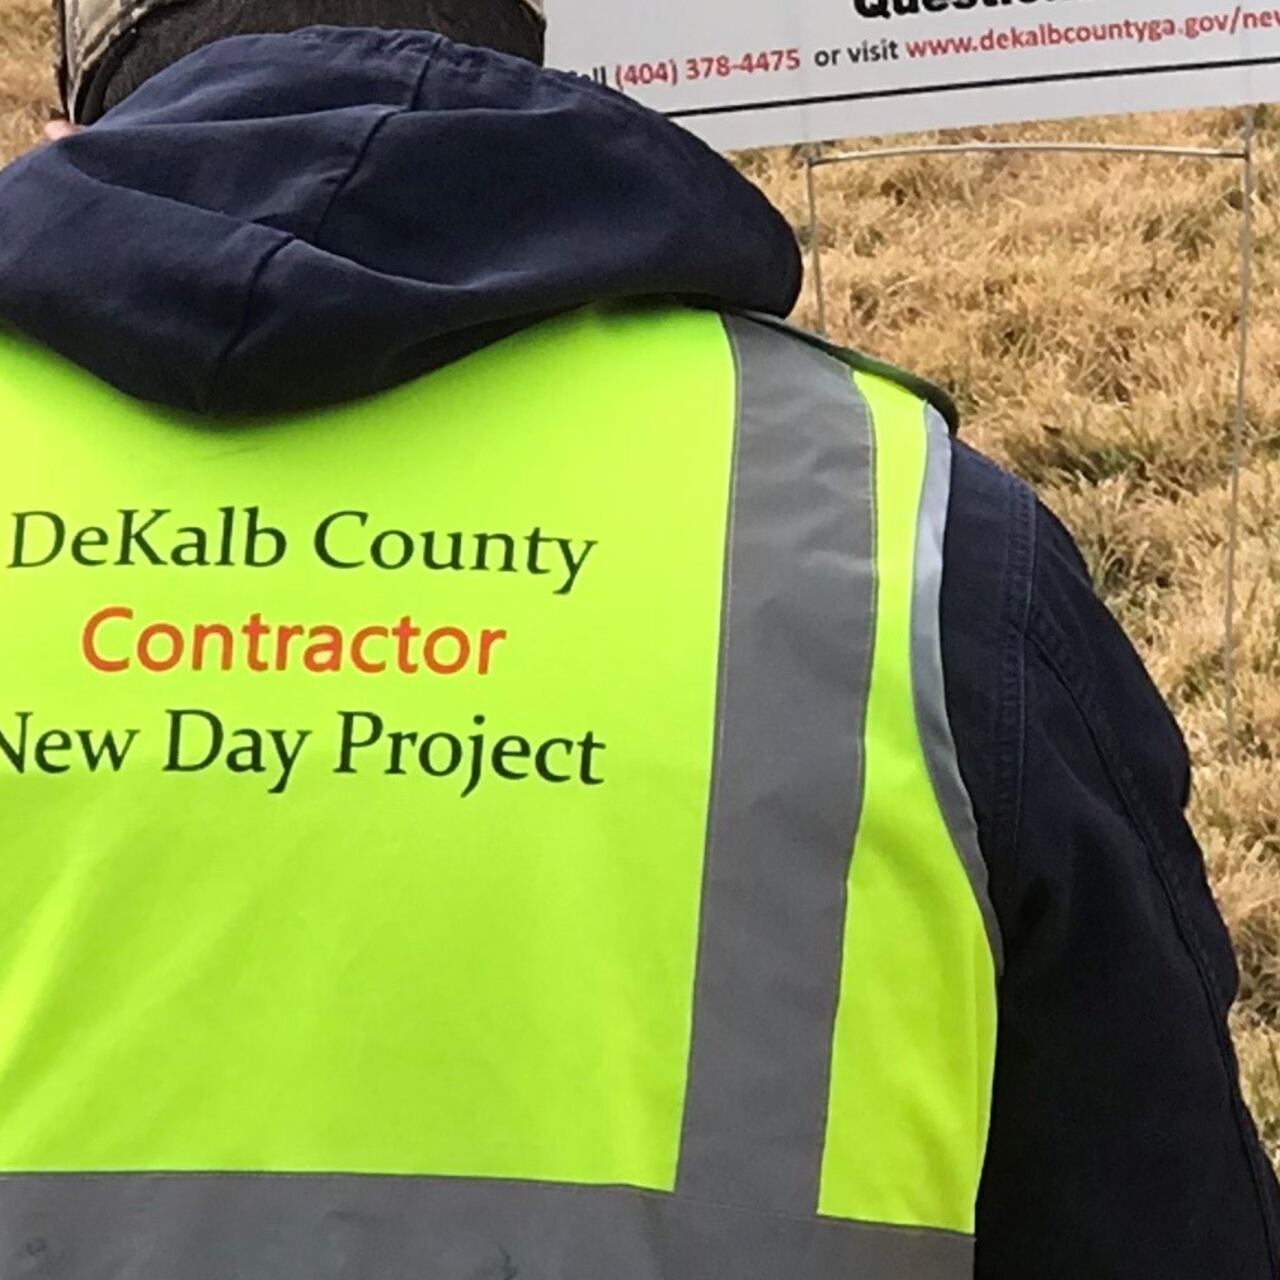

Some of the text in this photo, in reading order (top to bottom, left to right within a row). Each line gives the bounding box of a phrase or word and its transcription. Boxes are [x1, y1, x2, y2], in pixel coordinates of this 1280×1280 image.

[615, 59, 679, 92] (404)
[686, 47, 801, 82] 378-4475
[814, 49, 841, 68] or
[846, 38, 899, 64] visit
[7, 505, 599, 596] DeKalb County
[82, 606, 507, 676] Contractor
[161, 708, 313, 795] Day
[332, 710, 607, 799] Project
